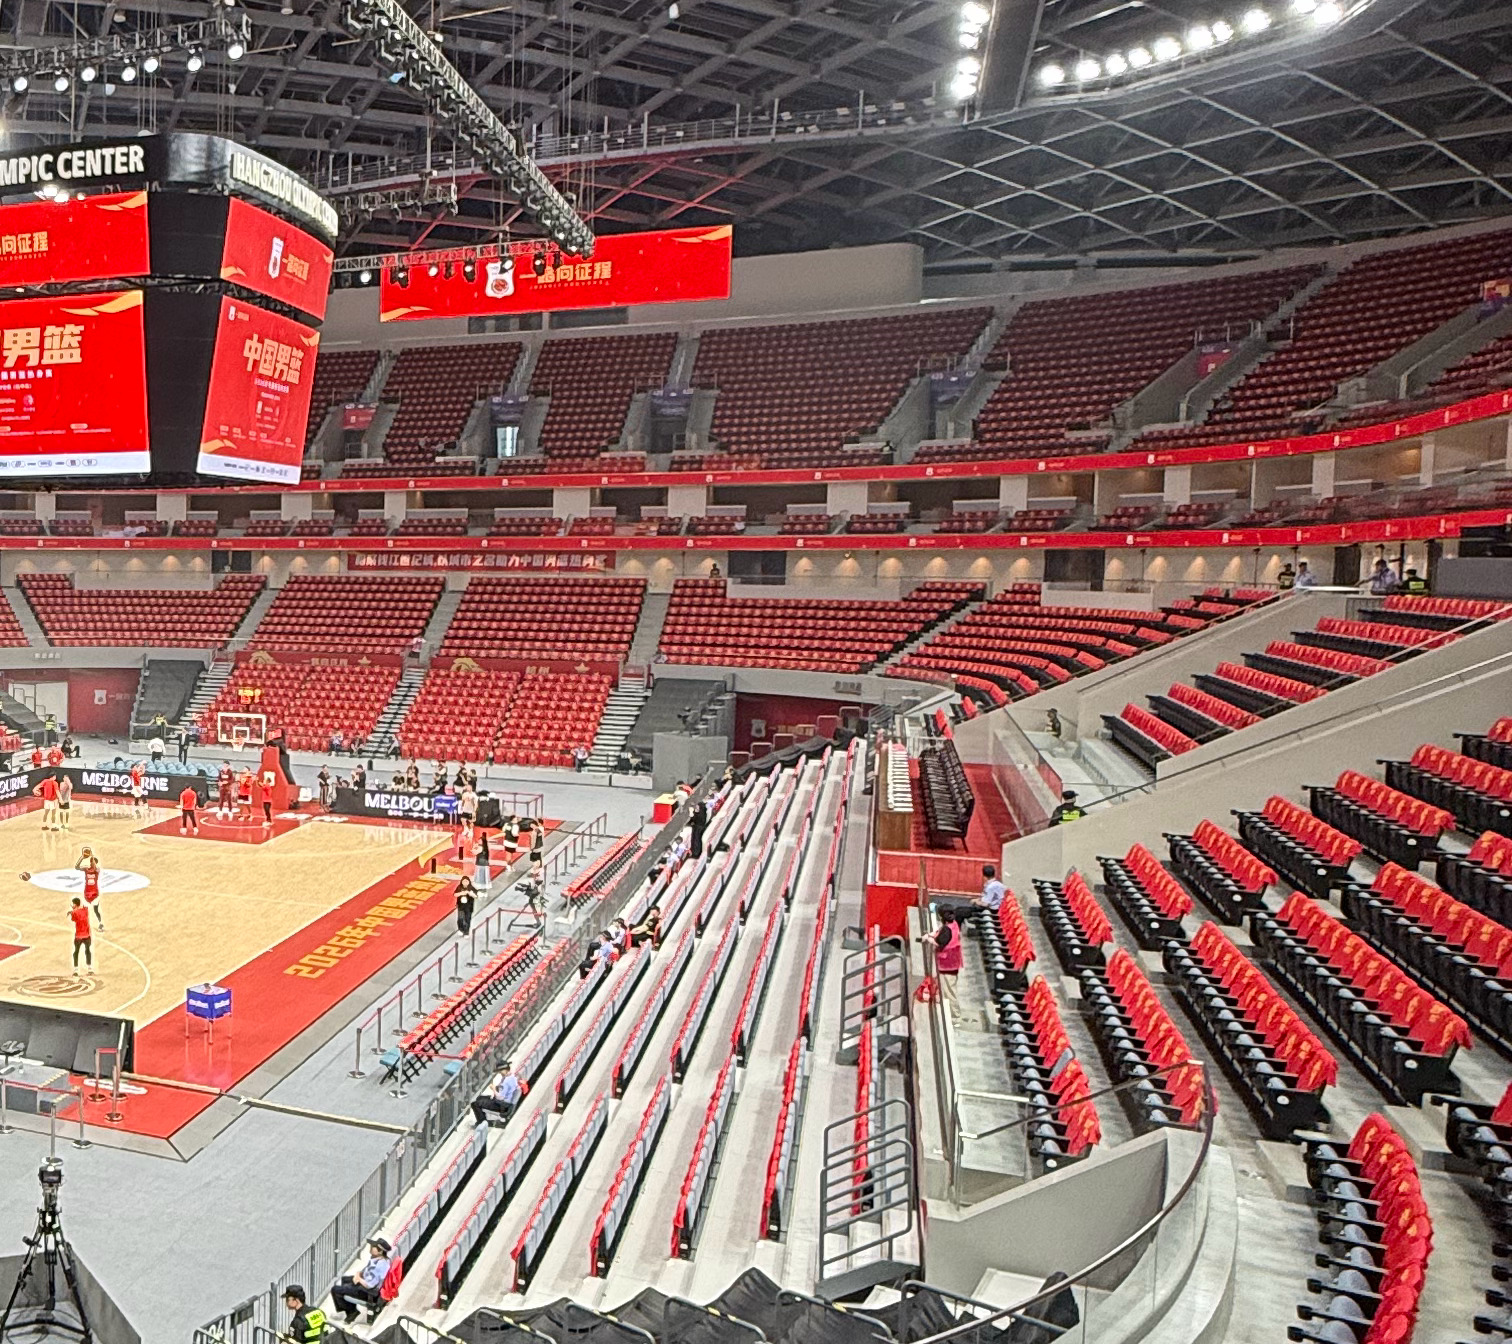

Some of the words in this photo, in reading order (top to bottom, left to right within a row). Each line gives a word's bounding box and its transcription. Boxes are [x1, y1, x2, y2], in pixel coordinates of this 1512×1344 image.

[56, 145, 145, 179] CENTER
[232, 152, 293, 202] HANGZHOU
[243, 333, 305, 385] 中国男篮
[82, 771, 169, 792] MELBORNE
[365, 792, 463, 815] MELBOU
